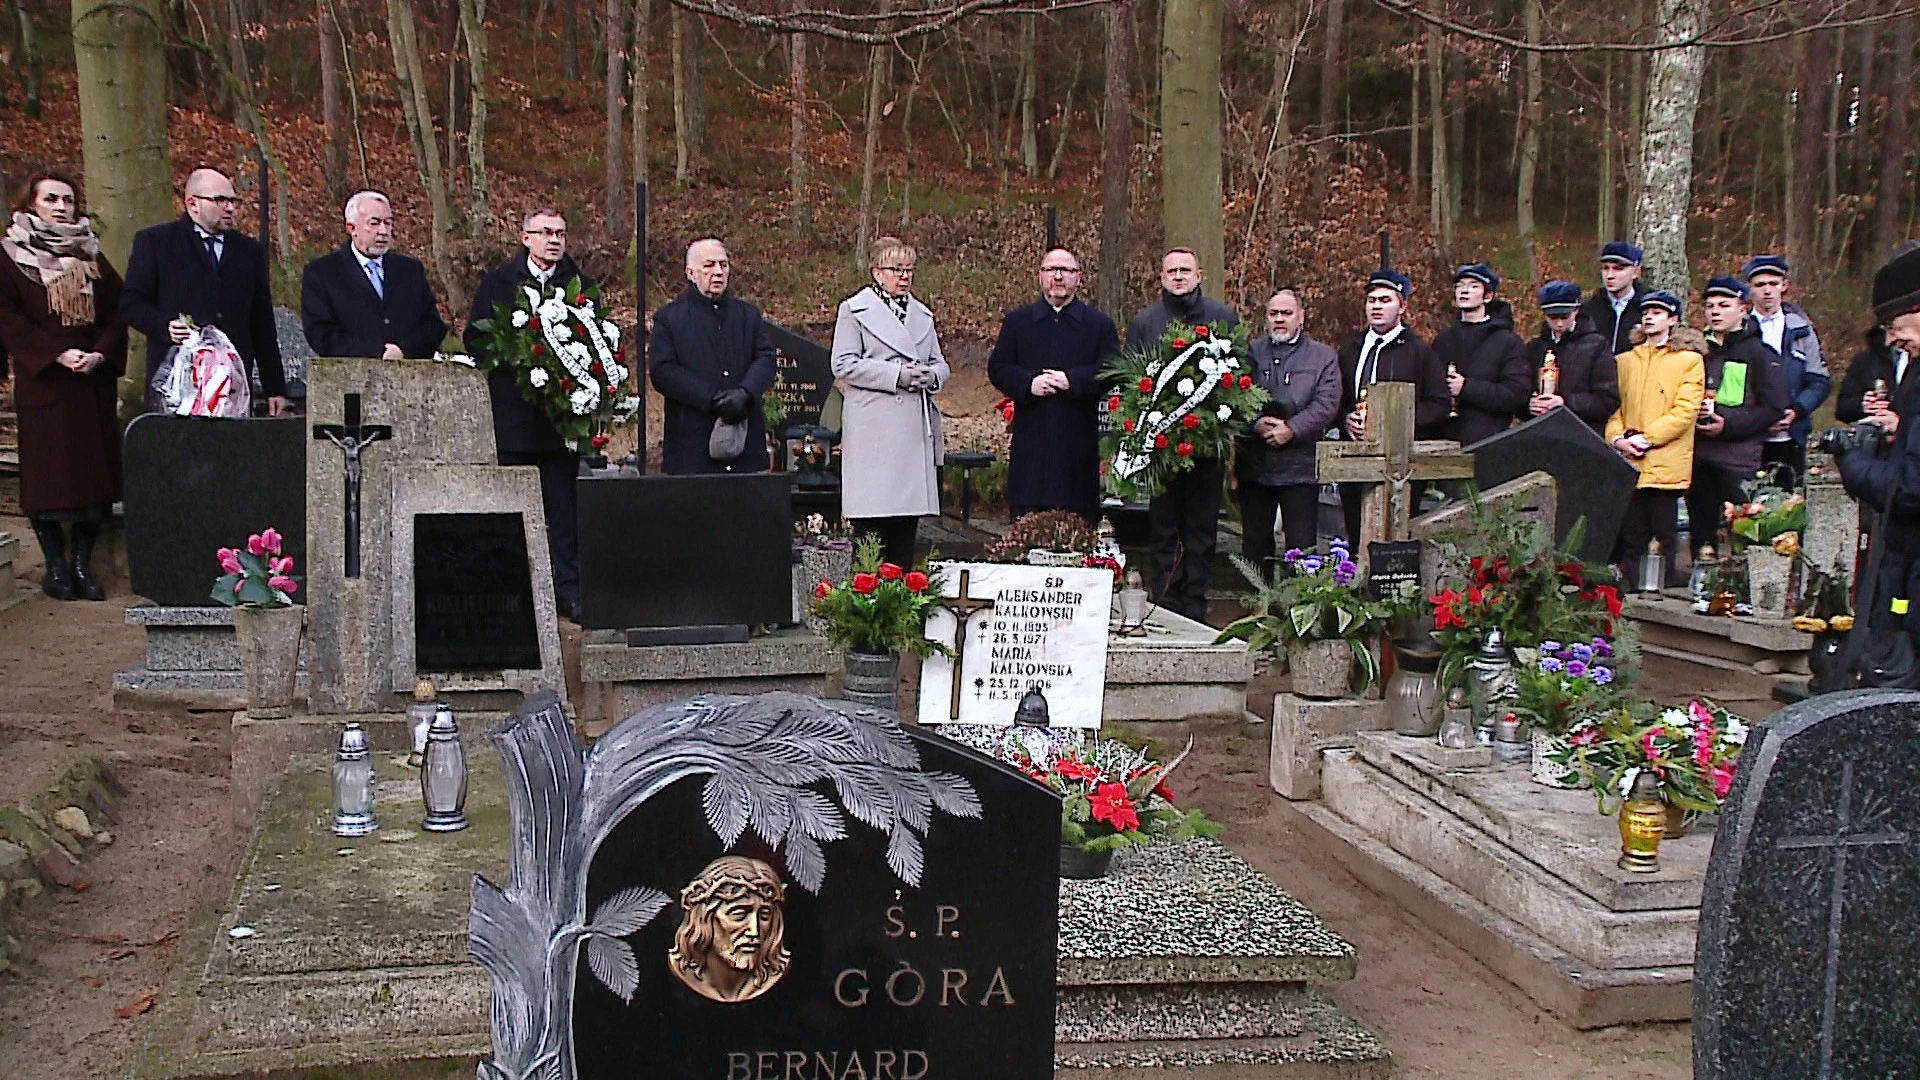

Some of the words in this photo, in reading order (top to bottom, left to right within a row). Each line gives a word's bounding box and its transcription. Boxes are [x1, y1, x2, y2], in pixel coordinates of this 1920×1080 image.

[997, 589, 1083, 605] ALEKSANDER
[994, 604, 1074, 620] KALKOWSKI
[991, 646, 1033, 660] MARIA
[990, 660, 1073, 677] KALKOWSKA
[727, 1050, 929, 1080] BERNARD
